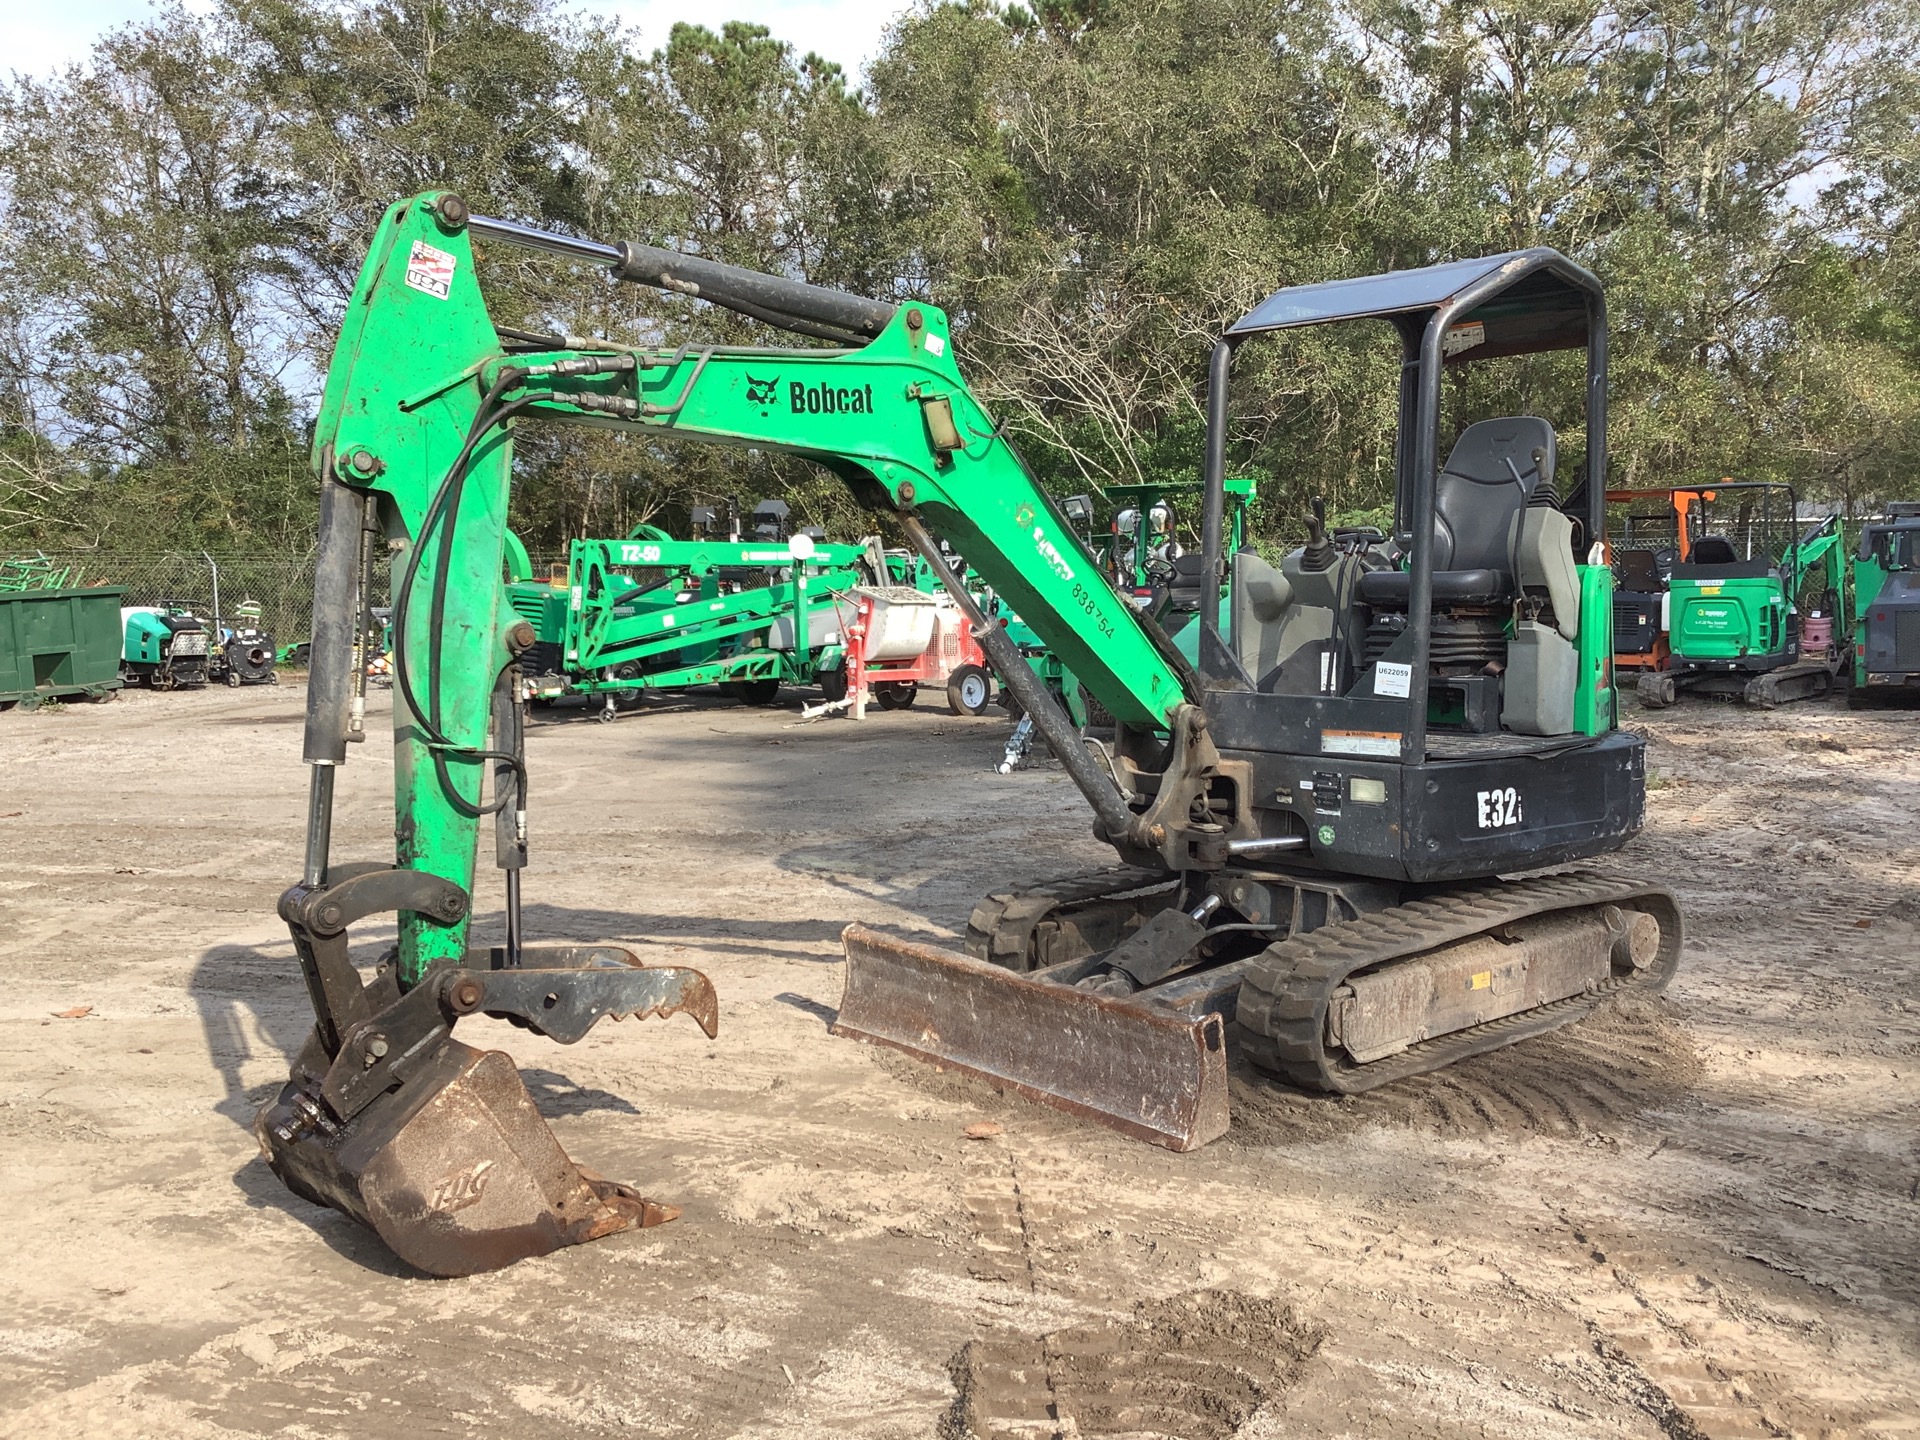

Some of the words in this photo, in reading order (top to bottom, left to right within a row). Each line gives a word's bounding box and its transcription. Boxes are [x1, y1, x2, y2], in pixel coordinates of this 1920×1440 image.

[408, 270, 447, 295] USA
[789, 381, 873, 415] Bobcat
[621, 545, 661, 562] TZ-50
[1072, 583, 1115, 640] 838754
[1378, 667, 1409, 677] U622059
[1477, 787, 1523, 828] E32i
